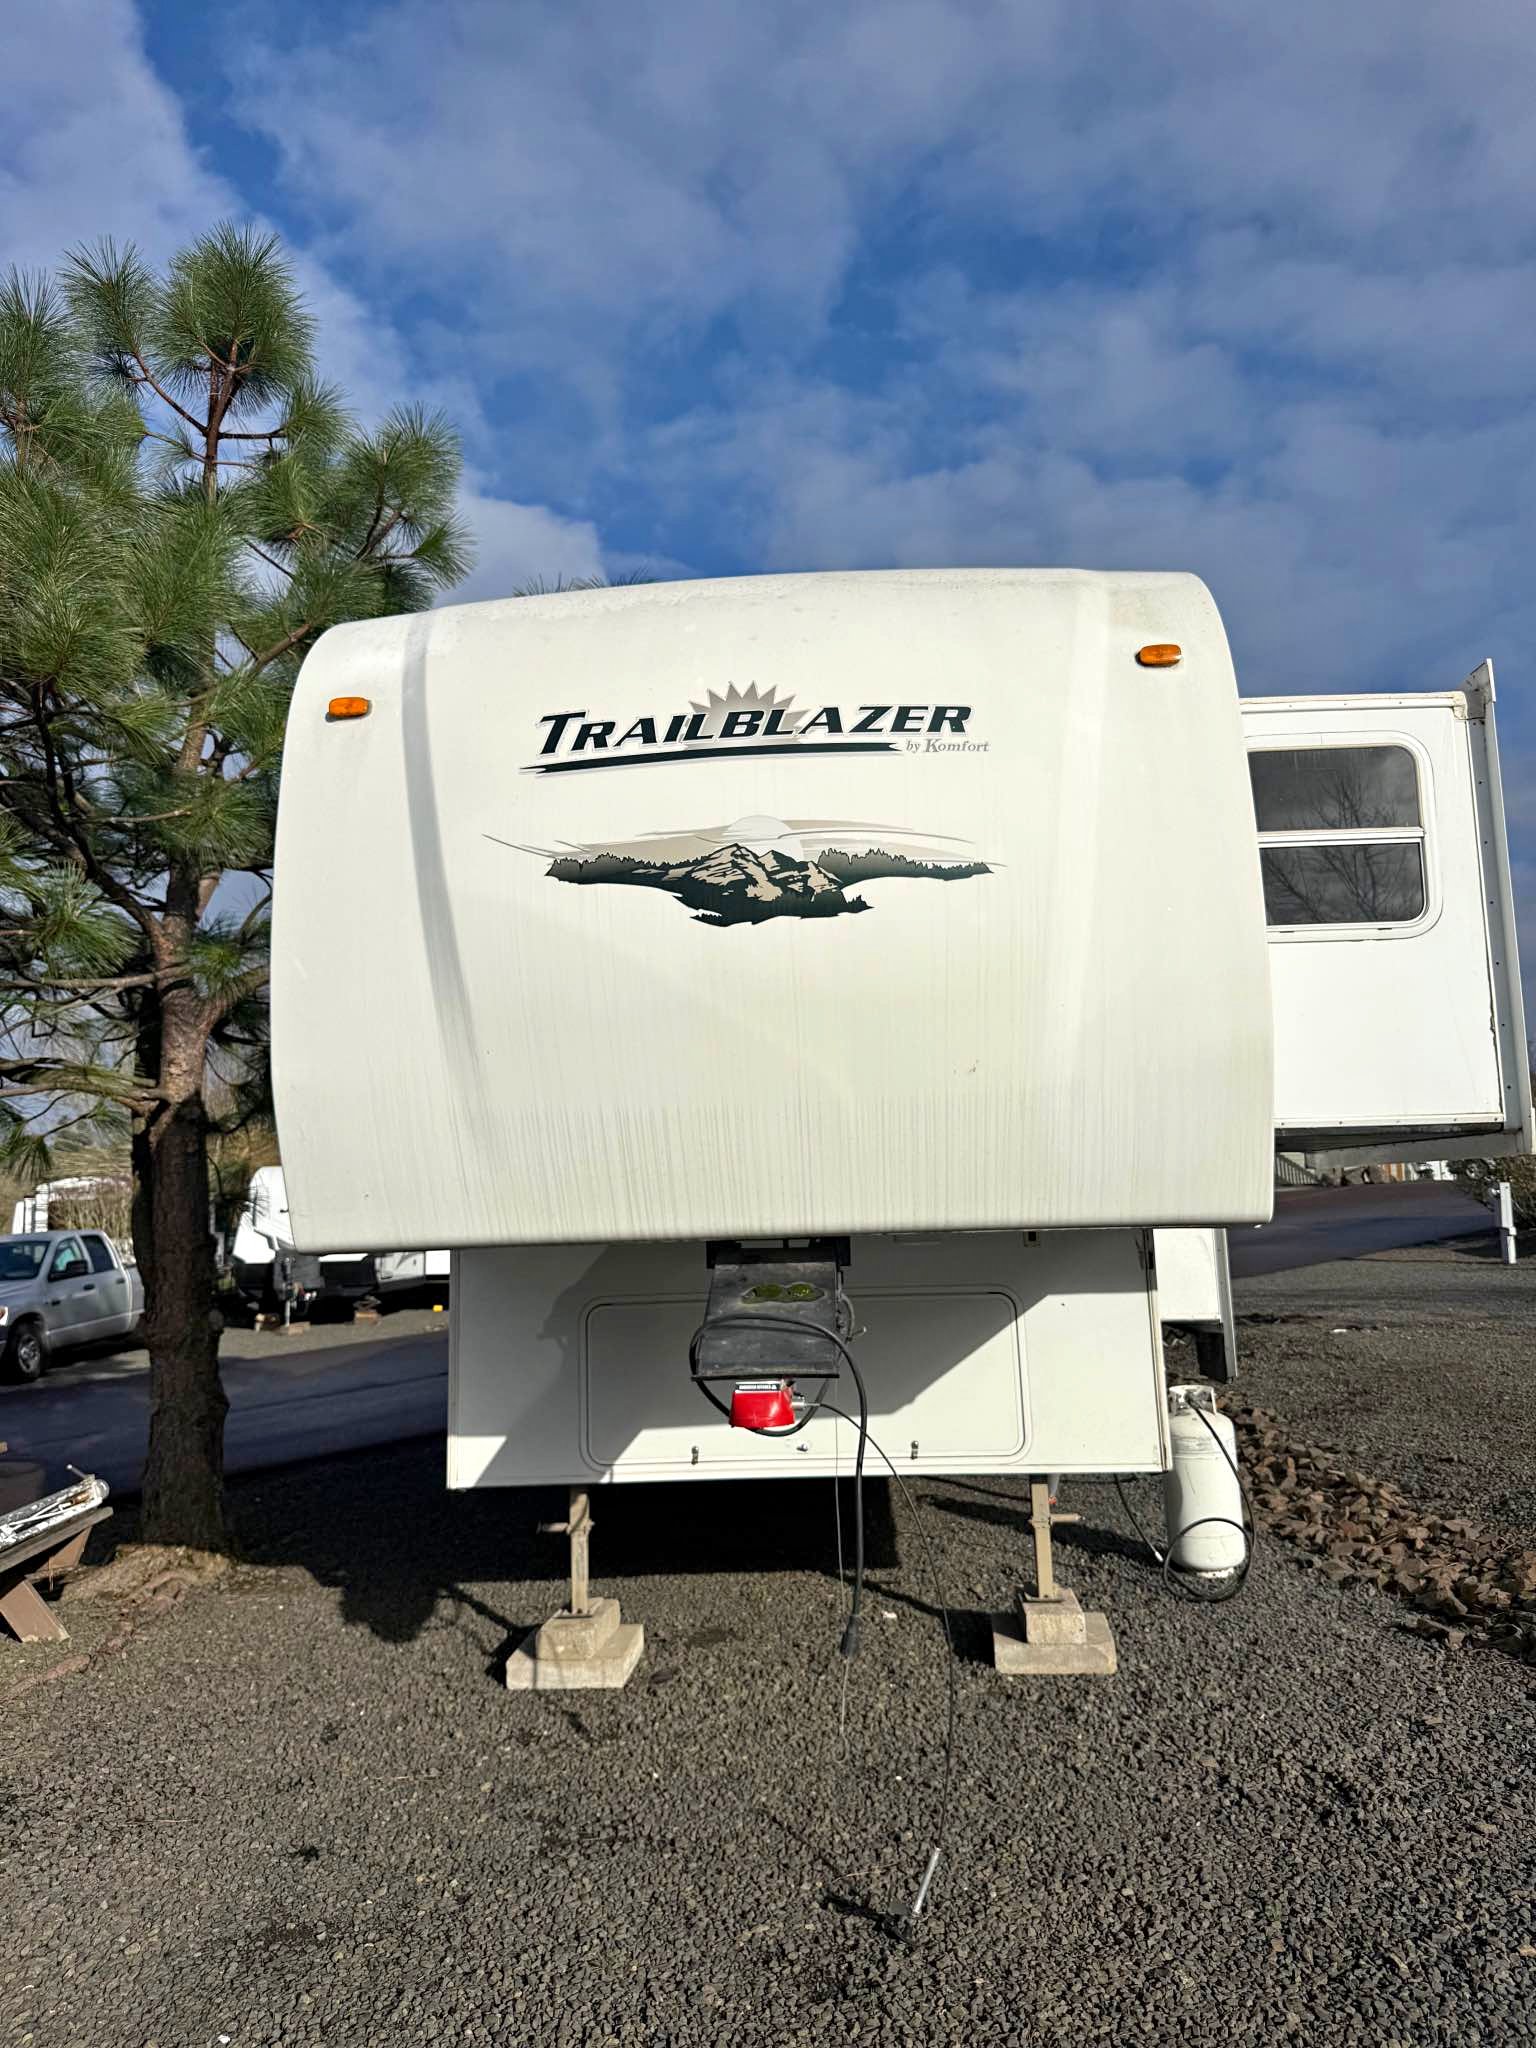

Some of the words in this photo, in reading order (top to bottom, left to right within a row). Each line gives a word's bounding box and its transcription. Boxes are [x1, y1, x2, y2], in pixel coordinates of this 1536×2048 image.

[539, 705, 972, 755] TRAILBLAZER
[906, 740, 921, 754] by
[923, 738, 990, 753] Komfort
